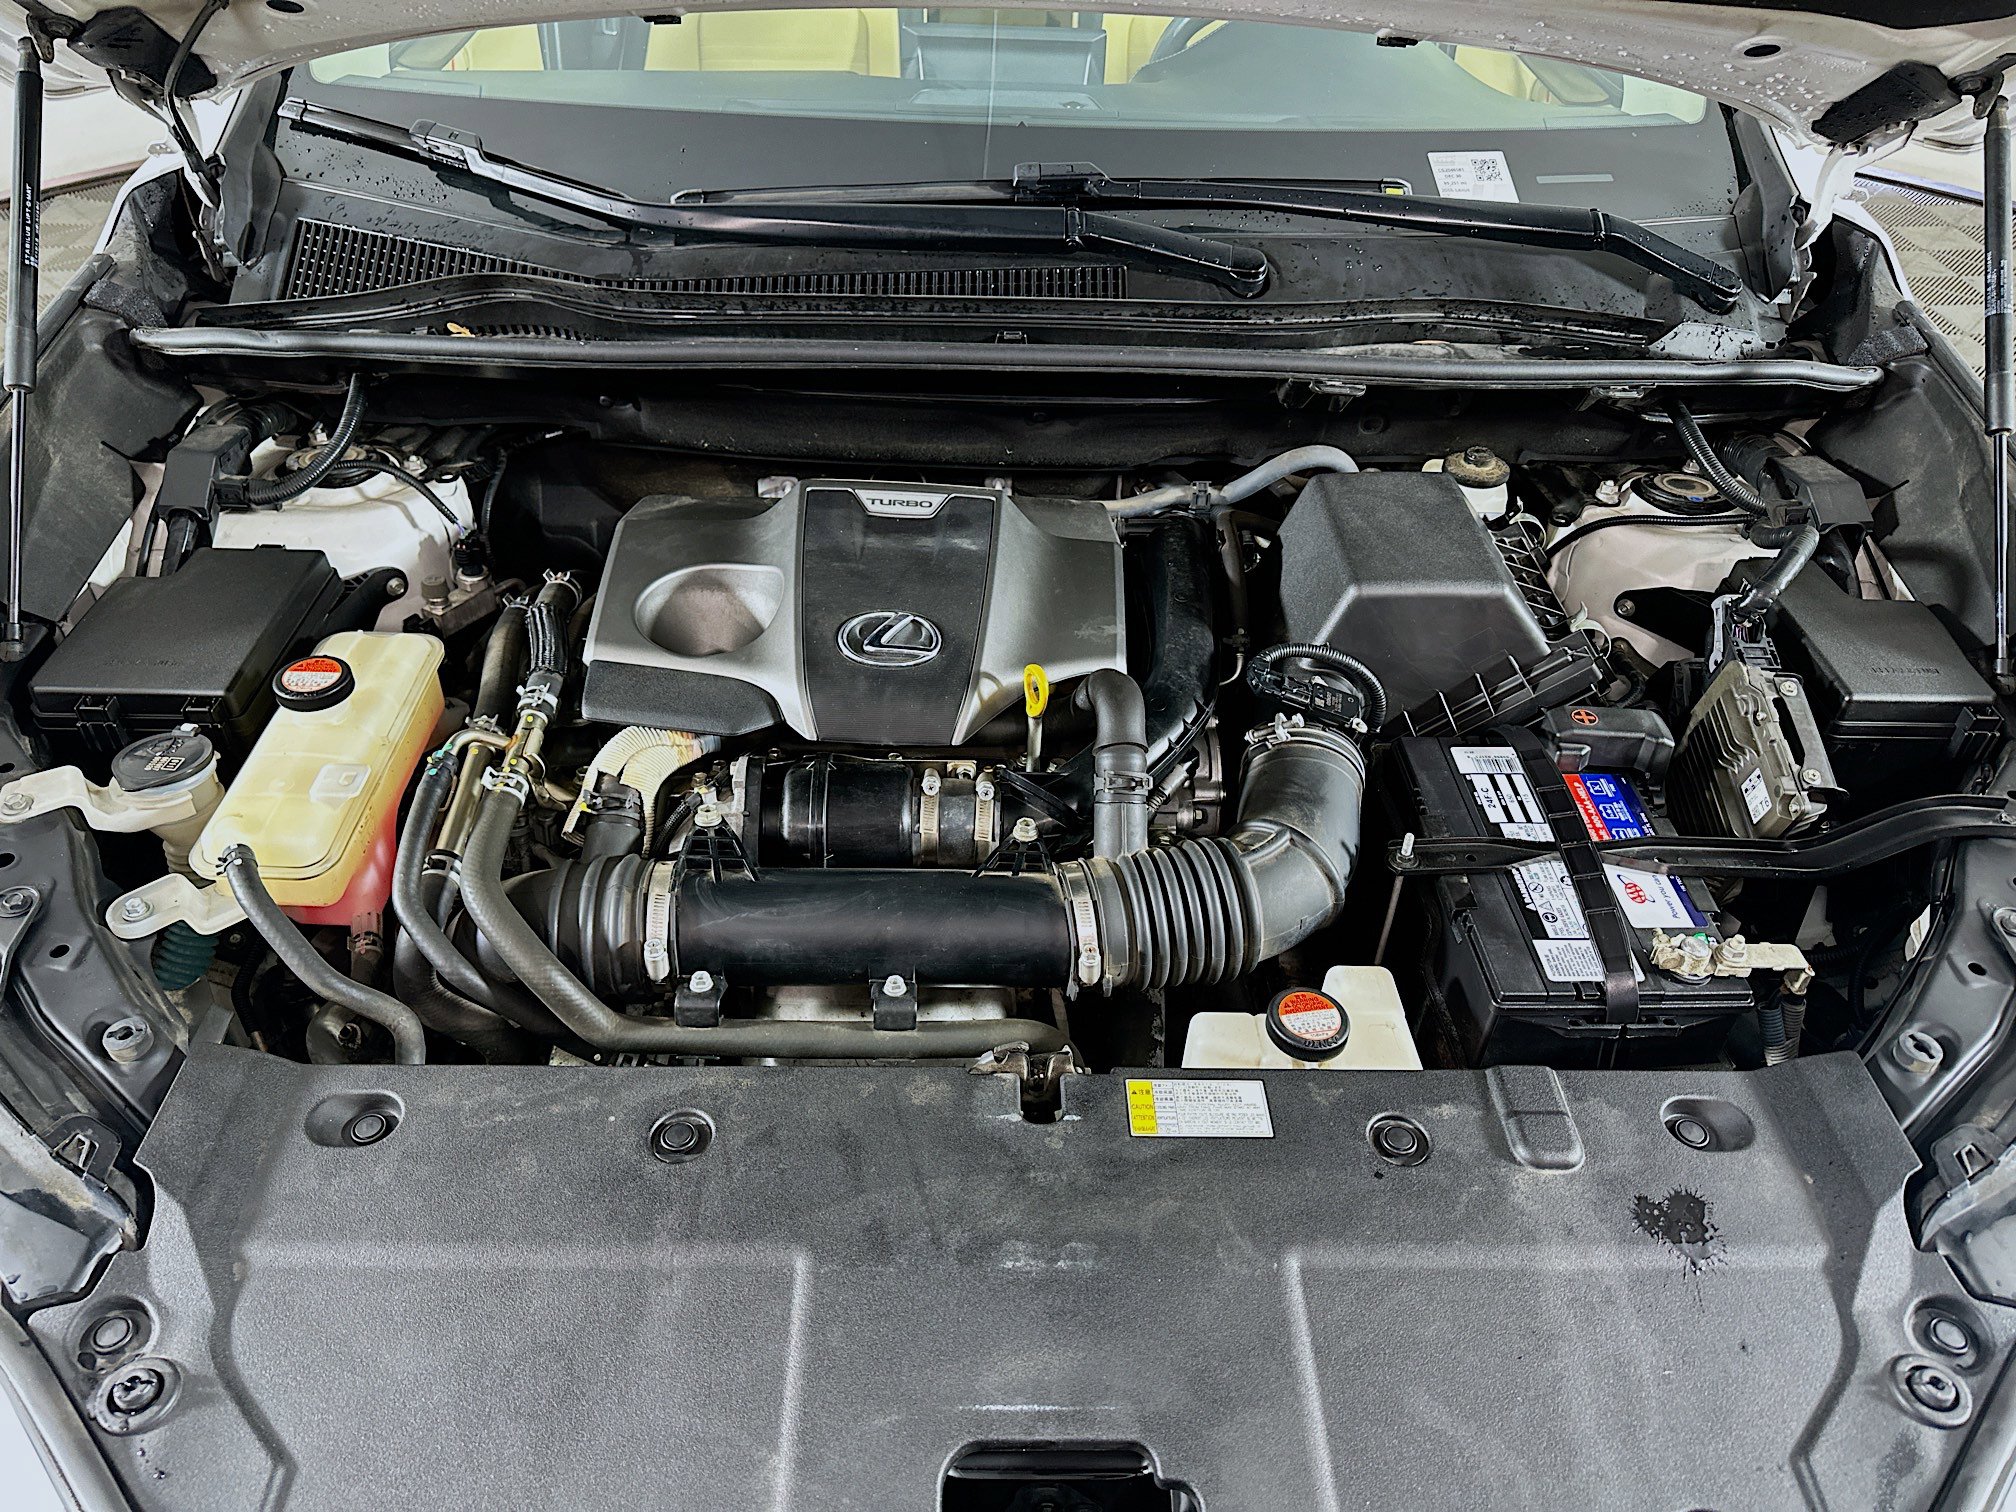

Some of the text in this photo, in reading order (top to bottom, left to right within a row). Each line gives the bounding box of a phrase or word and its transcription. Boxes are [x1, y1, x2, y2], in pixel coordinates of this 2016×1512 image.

[866, 497, 933, 508] TURBO
[1626, 884, 1646, 903] AAA
[1659, 886, 1671, 899] you
[1666, 898, 1680, 919] Power
